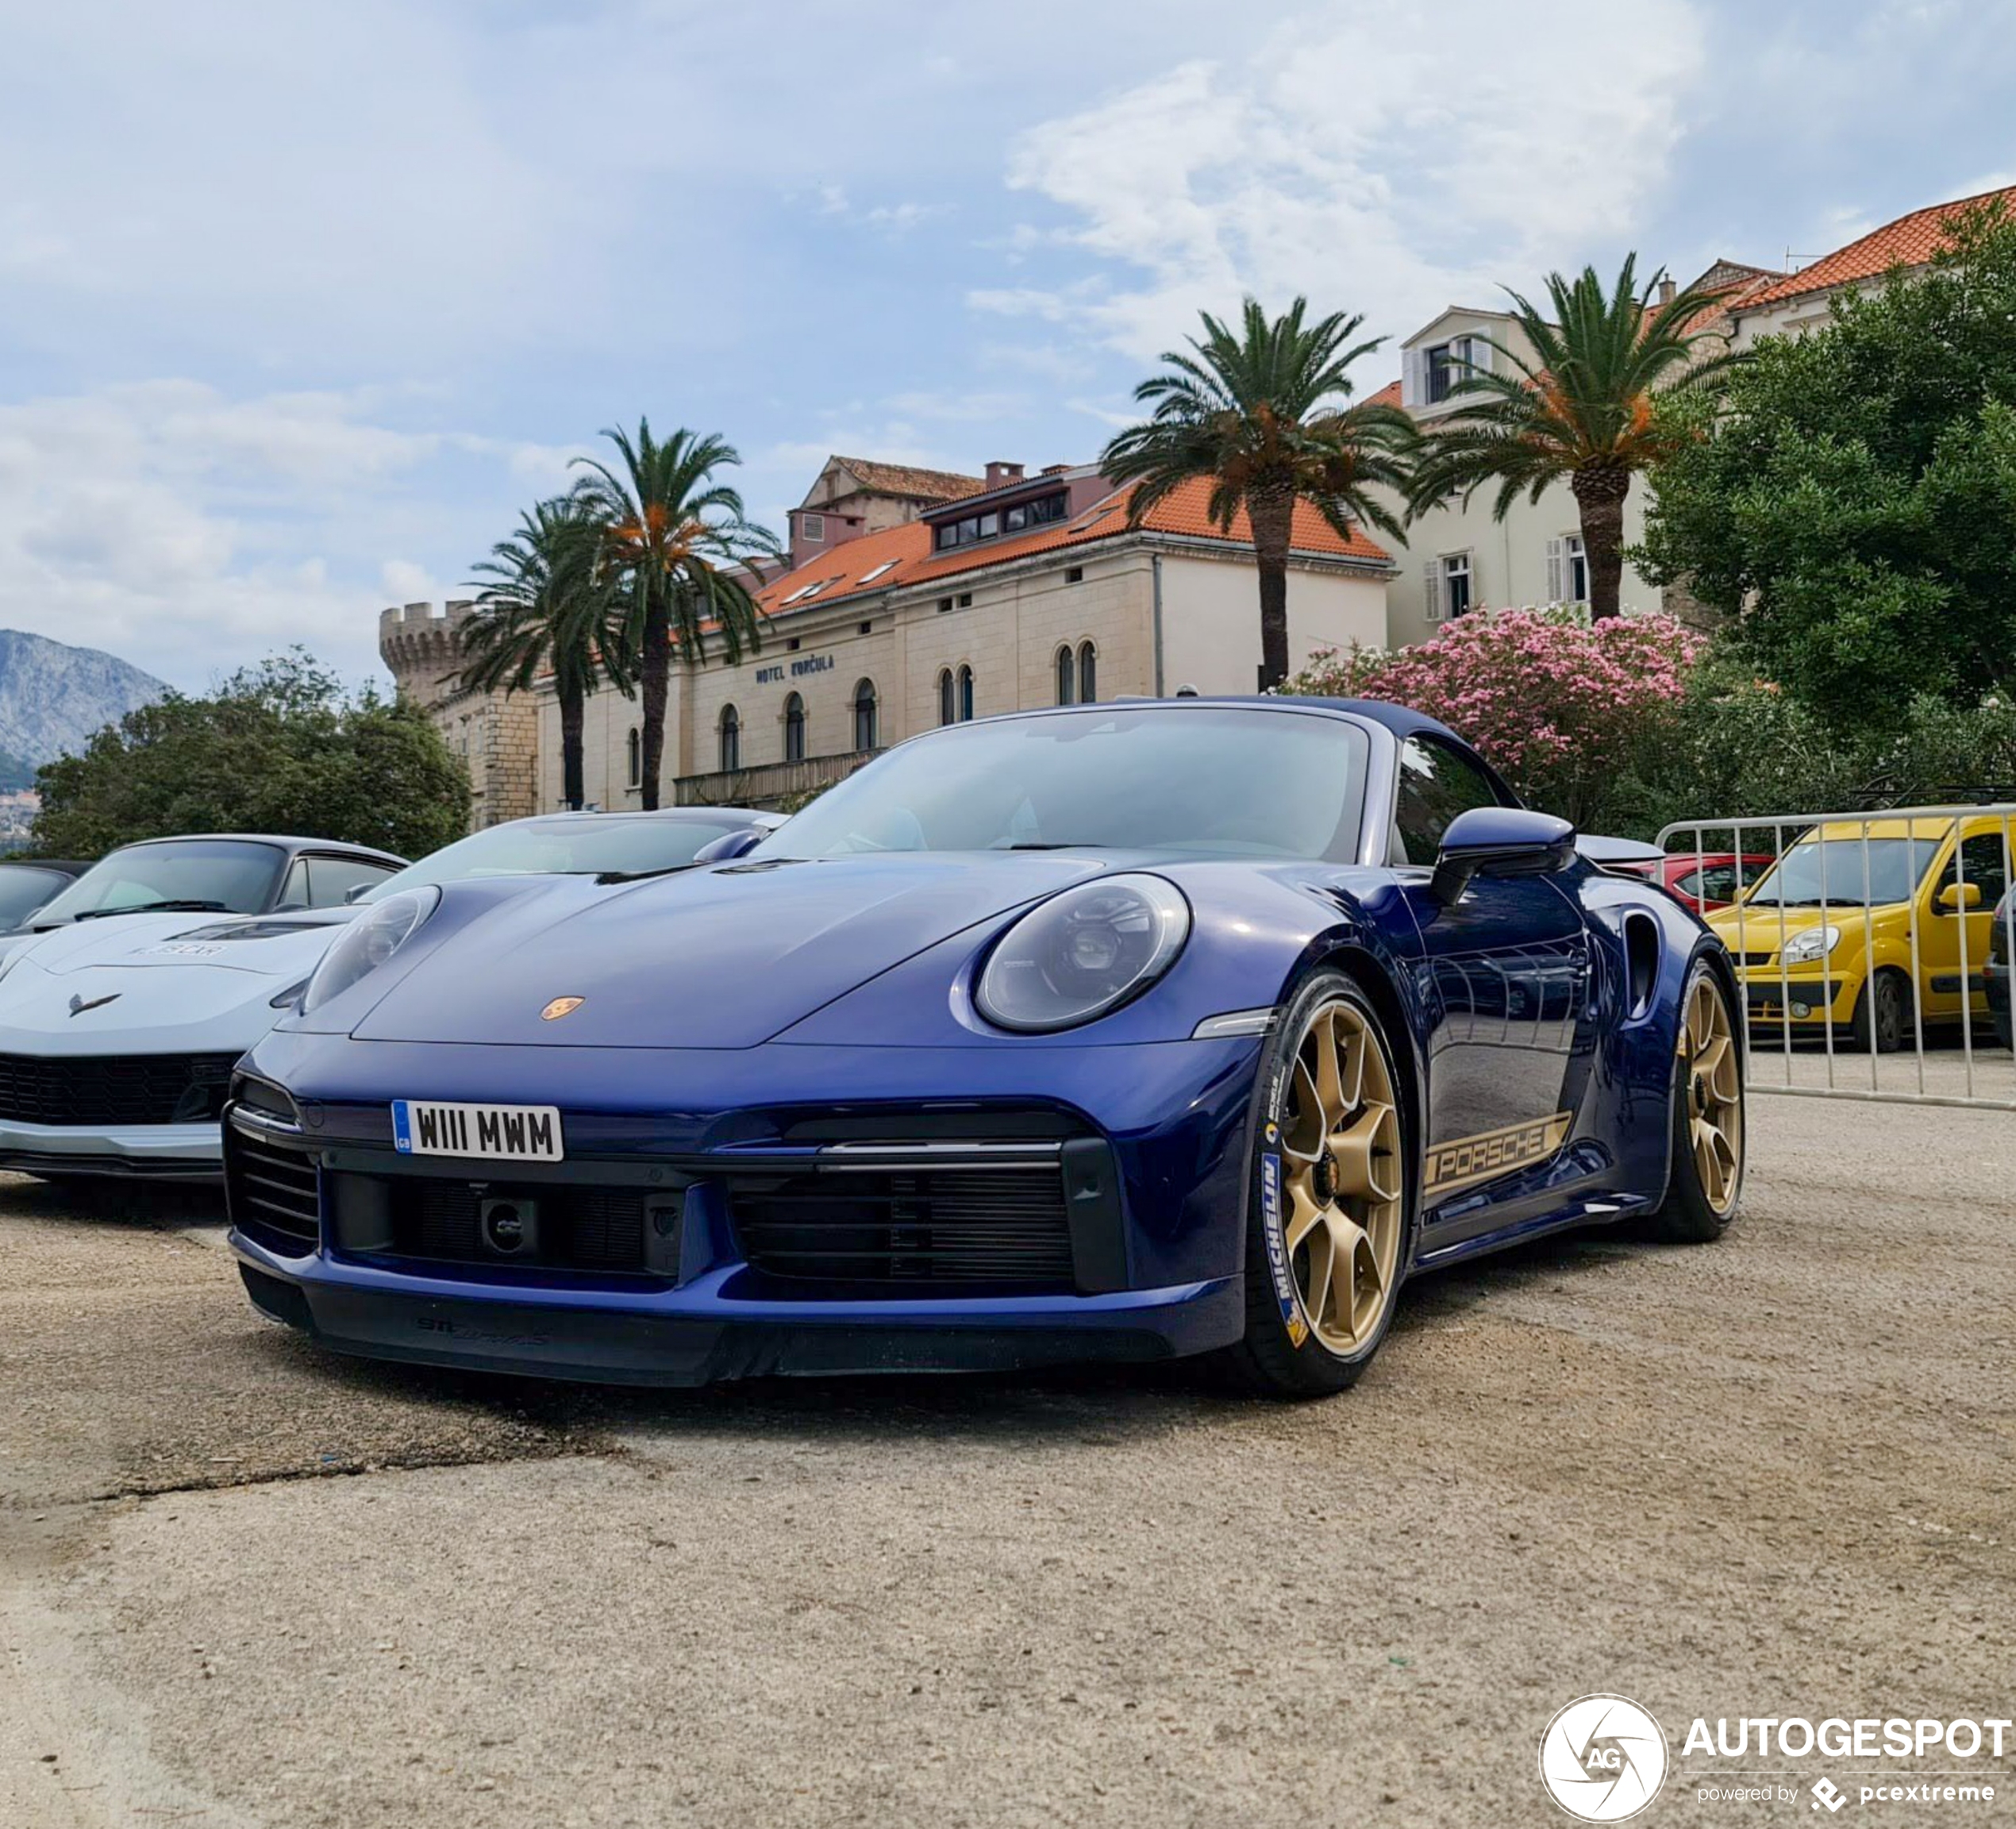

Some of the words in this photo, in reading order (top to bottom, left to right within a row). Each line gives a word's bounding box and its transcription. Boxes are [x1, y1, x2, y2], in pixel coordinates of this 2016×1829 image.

[756, 665, 785, 684] HOTEL
[791, 653, 834, 676] KORČULA
[476, 1111, 554, 1154] MWM
[1438, 1126, 1545, 1181] PORSCHE
[1264, 1161, 1291, 1300] MICHELIN
